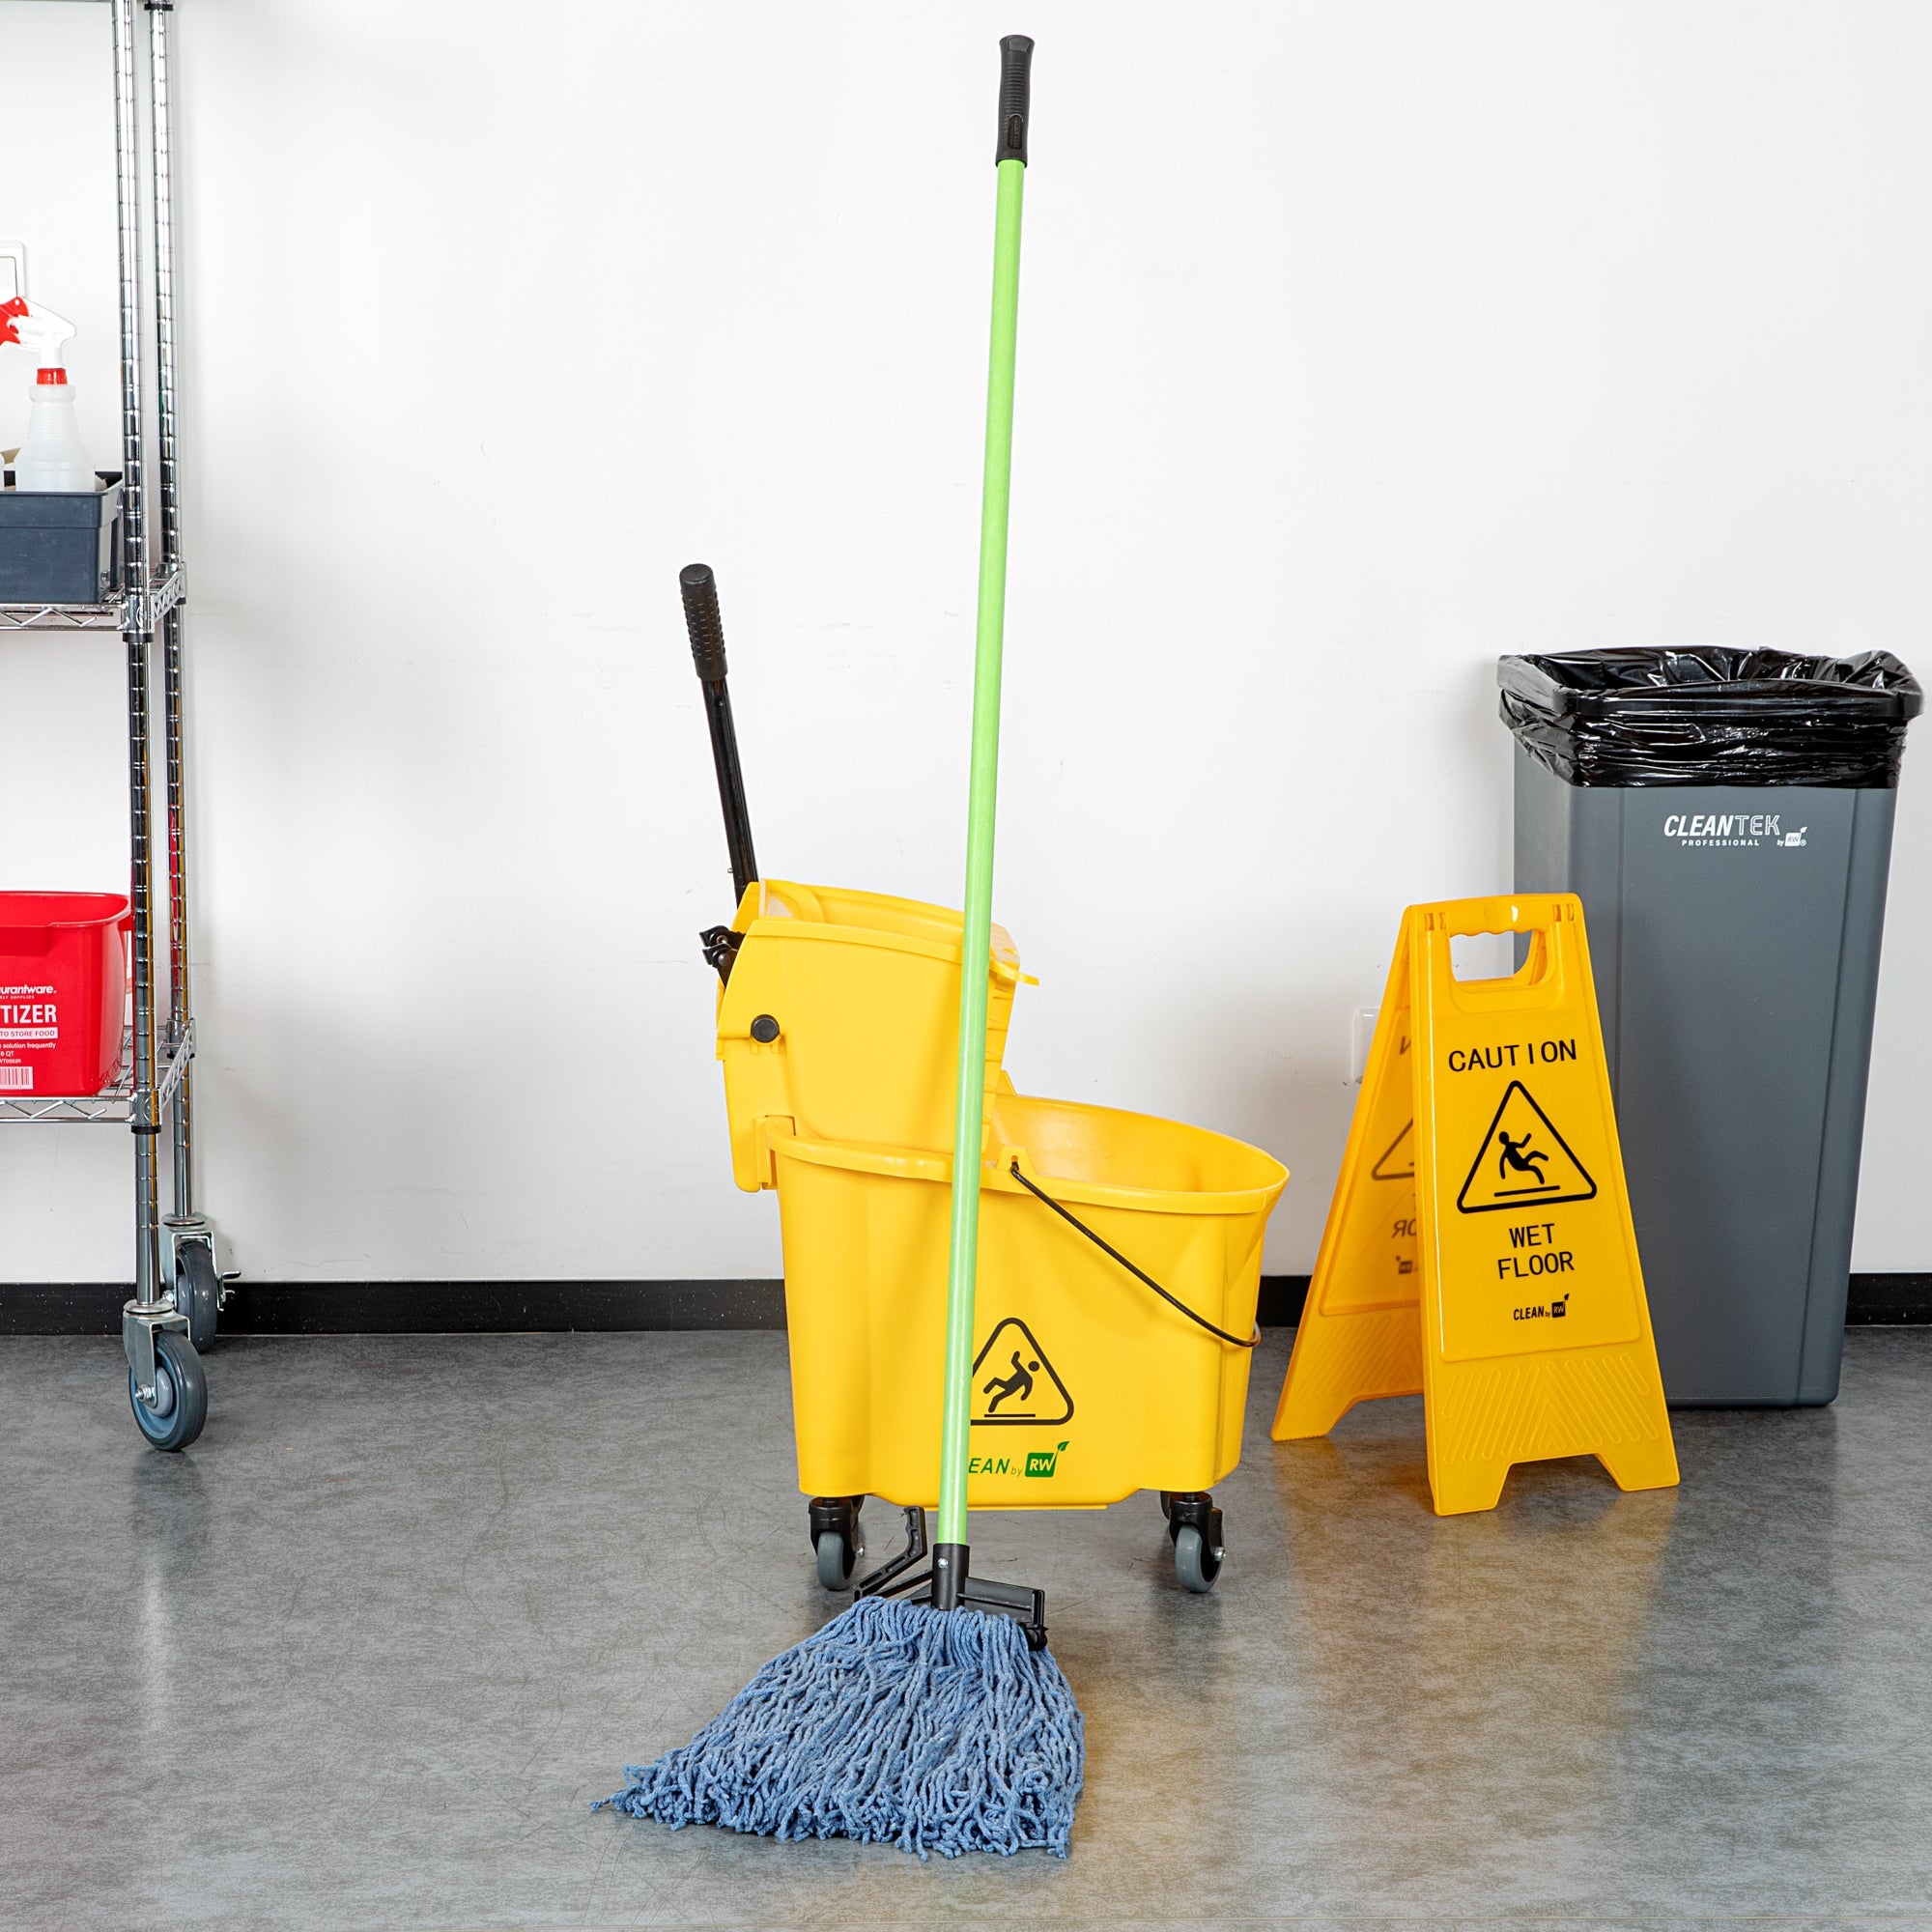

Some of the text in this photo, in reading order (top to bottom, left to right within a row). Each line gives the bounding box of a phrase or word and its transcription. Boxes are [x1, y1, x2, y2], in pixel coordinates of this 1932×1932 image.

[1663, 814, 1780, 837] CLEANTEK
[0, 1005, 57, 1024] TIZER
[1449, 1039, 1577, 1072] CAUTION
[1509, 1223, 1554, 1248] WET
[1498, 1251, 1575, 1279] FLOOR
[1514, 1306, 1544, 1321] CLEAN
[968, 1457, 1055, 1477] EAN by RW
